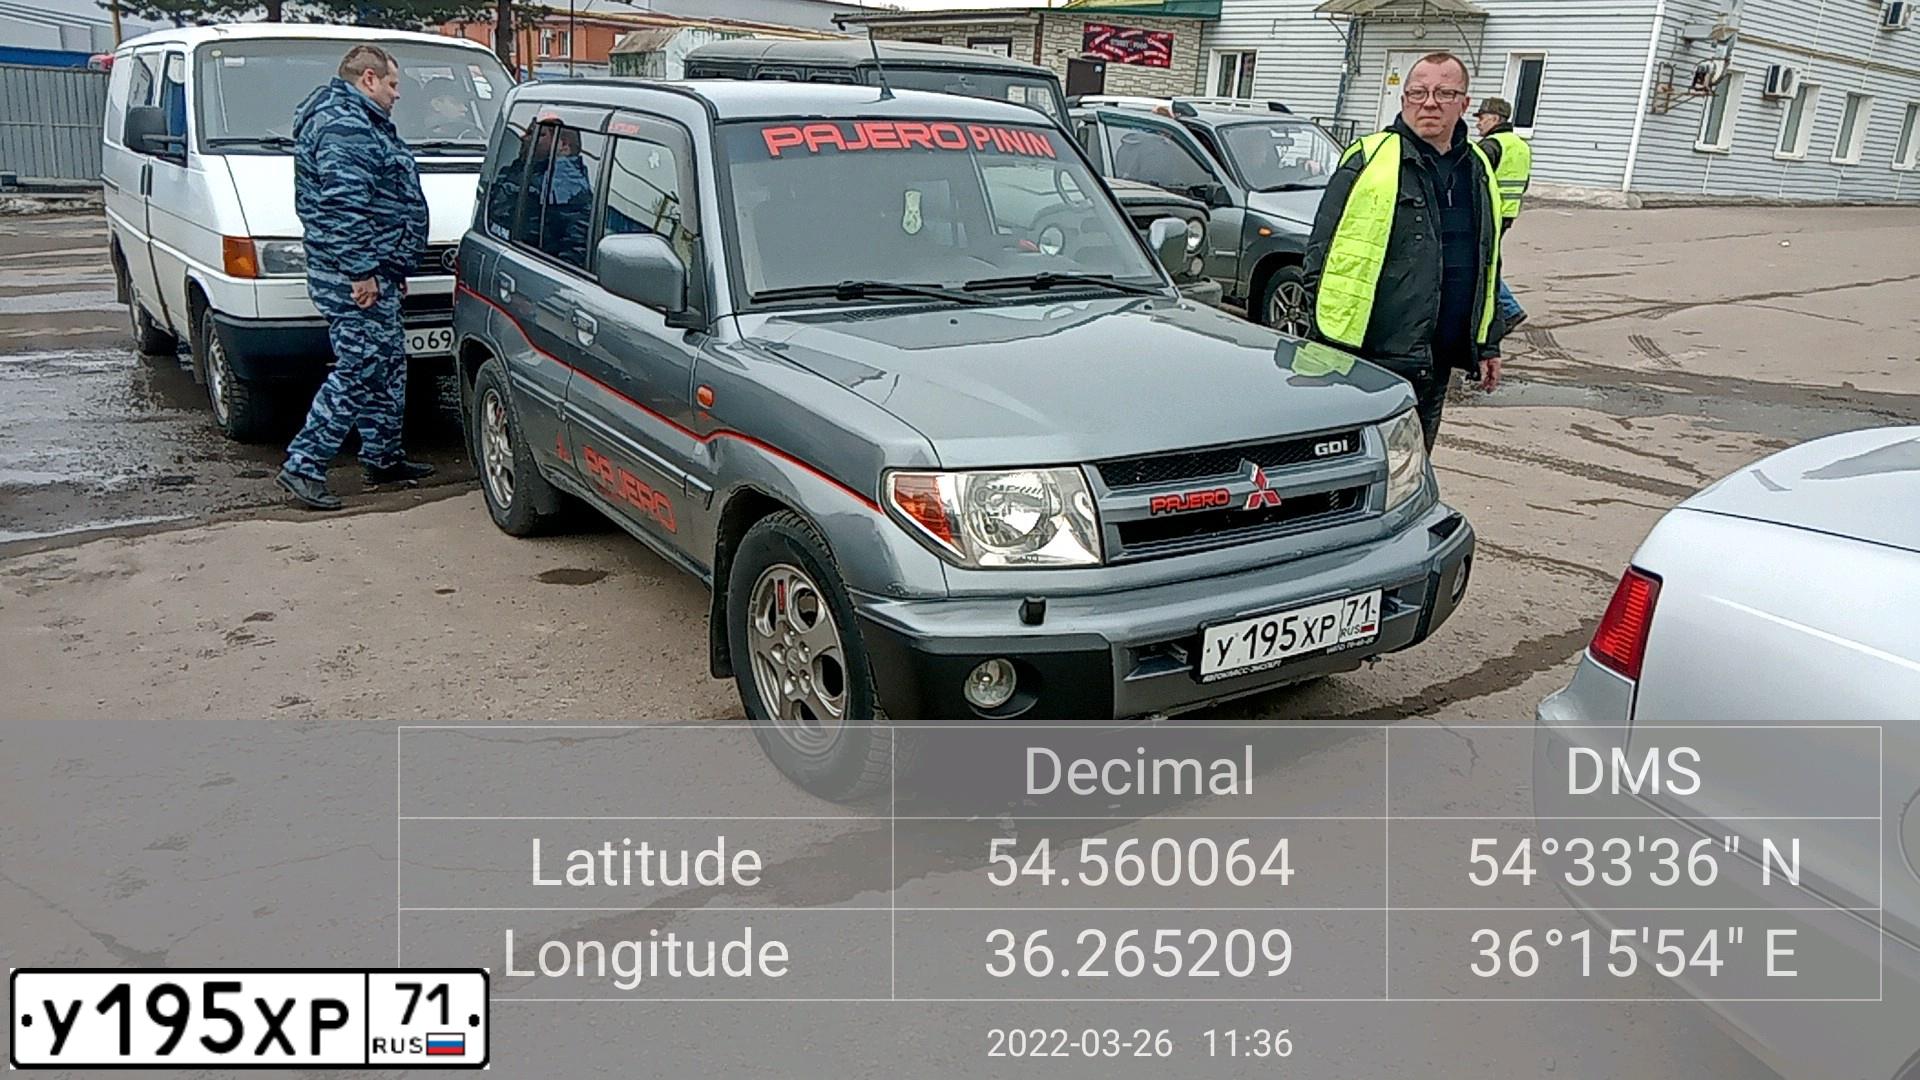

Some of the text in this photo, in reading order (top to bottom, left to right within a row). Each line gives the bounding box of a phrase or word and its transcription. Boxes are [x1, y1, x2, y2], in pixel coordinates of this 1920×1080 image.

[761, 122, 1056, 159] PAJERO PININ
[1314, 439, 1348, 456] GDI
[582, 444, 678, 534] PAJERO
[1150, 488, 1230, 515] PAJERO
[1346, 595, 1372, 626] 71
[1340, 624, 1360, 638] RUS
